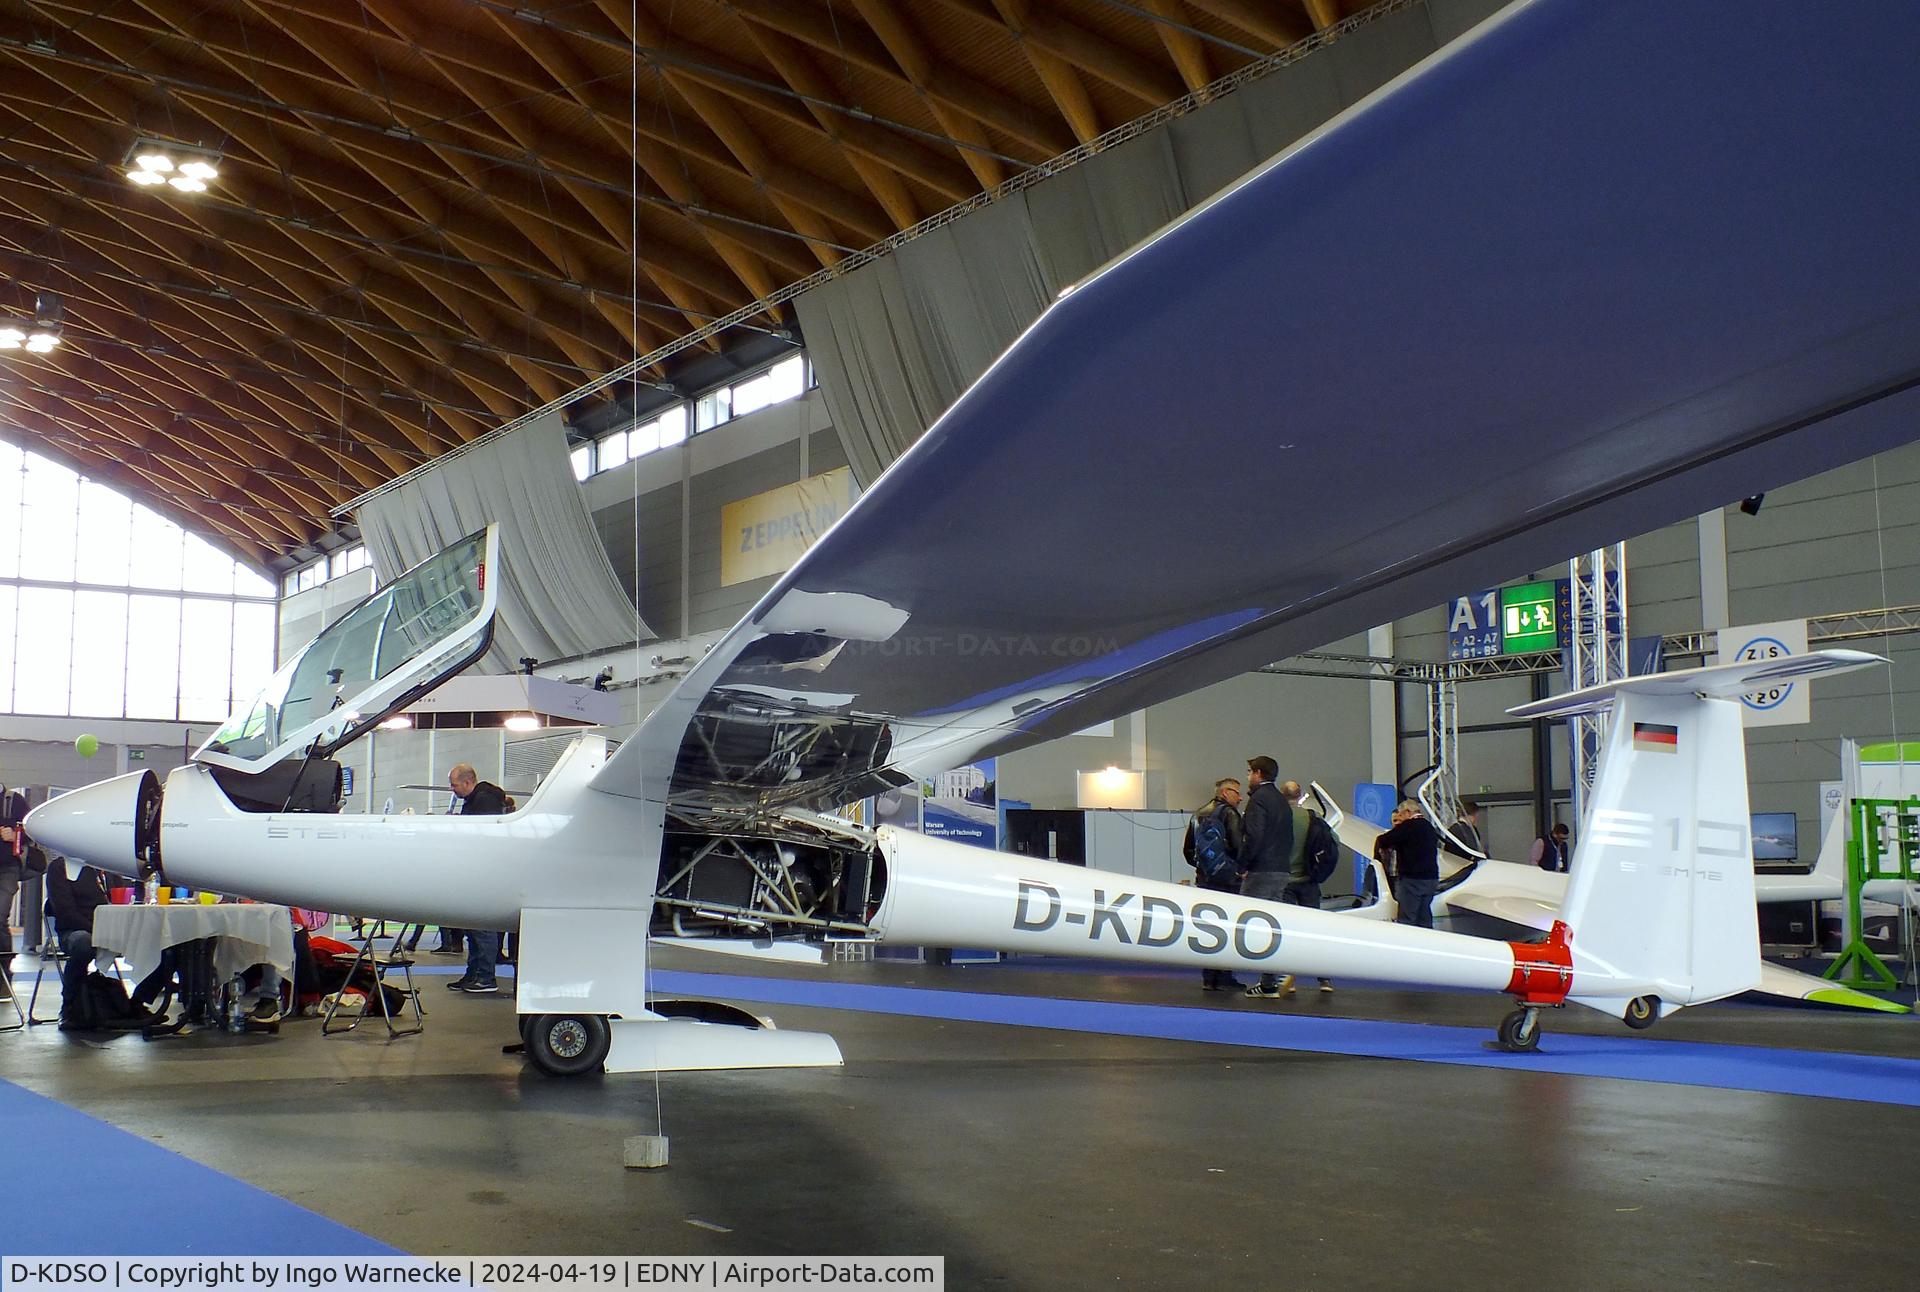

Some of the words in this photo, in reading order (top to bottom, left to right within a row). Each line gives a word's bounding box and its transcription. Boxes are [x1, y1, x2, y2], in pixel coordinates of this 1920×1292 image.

[741, 501, 838, 553] ZEPPELIN
[1462, 635, 1476, 646] A2
[1483, 632, 1498, 644] A7
[1462, 647, 1476, 658] B1
[1483, 645, 1498, 656] B5
[956, 829, 982, 837] Technology
[1013, 878, 1282, 960] D-KDSO
